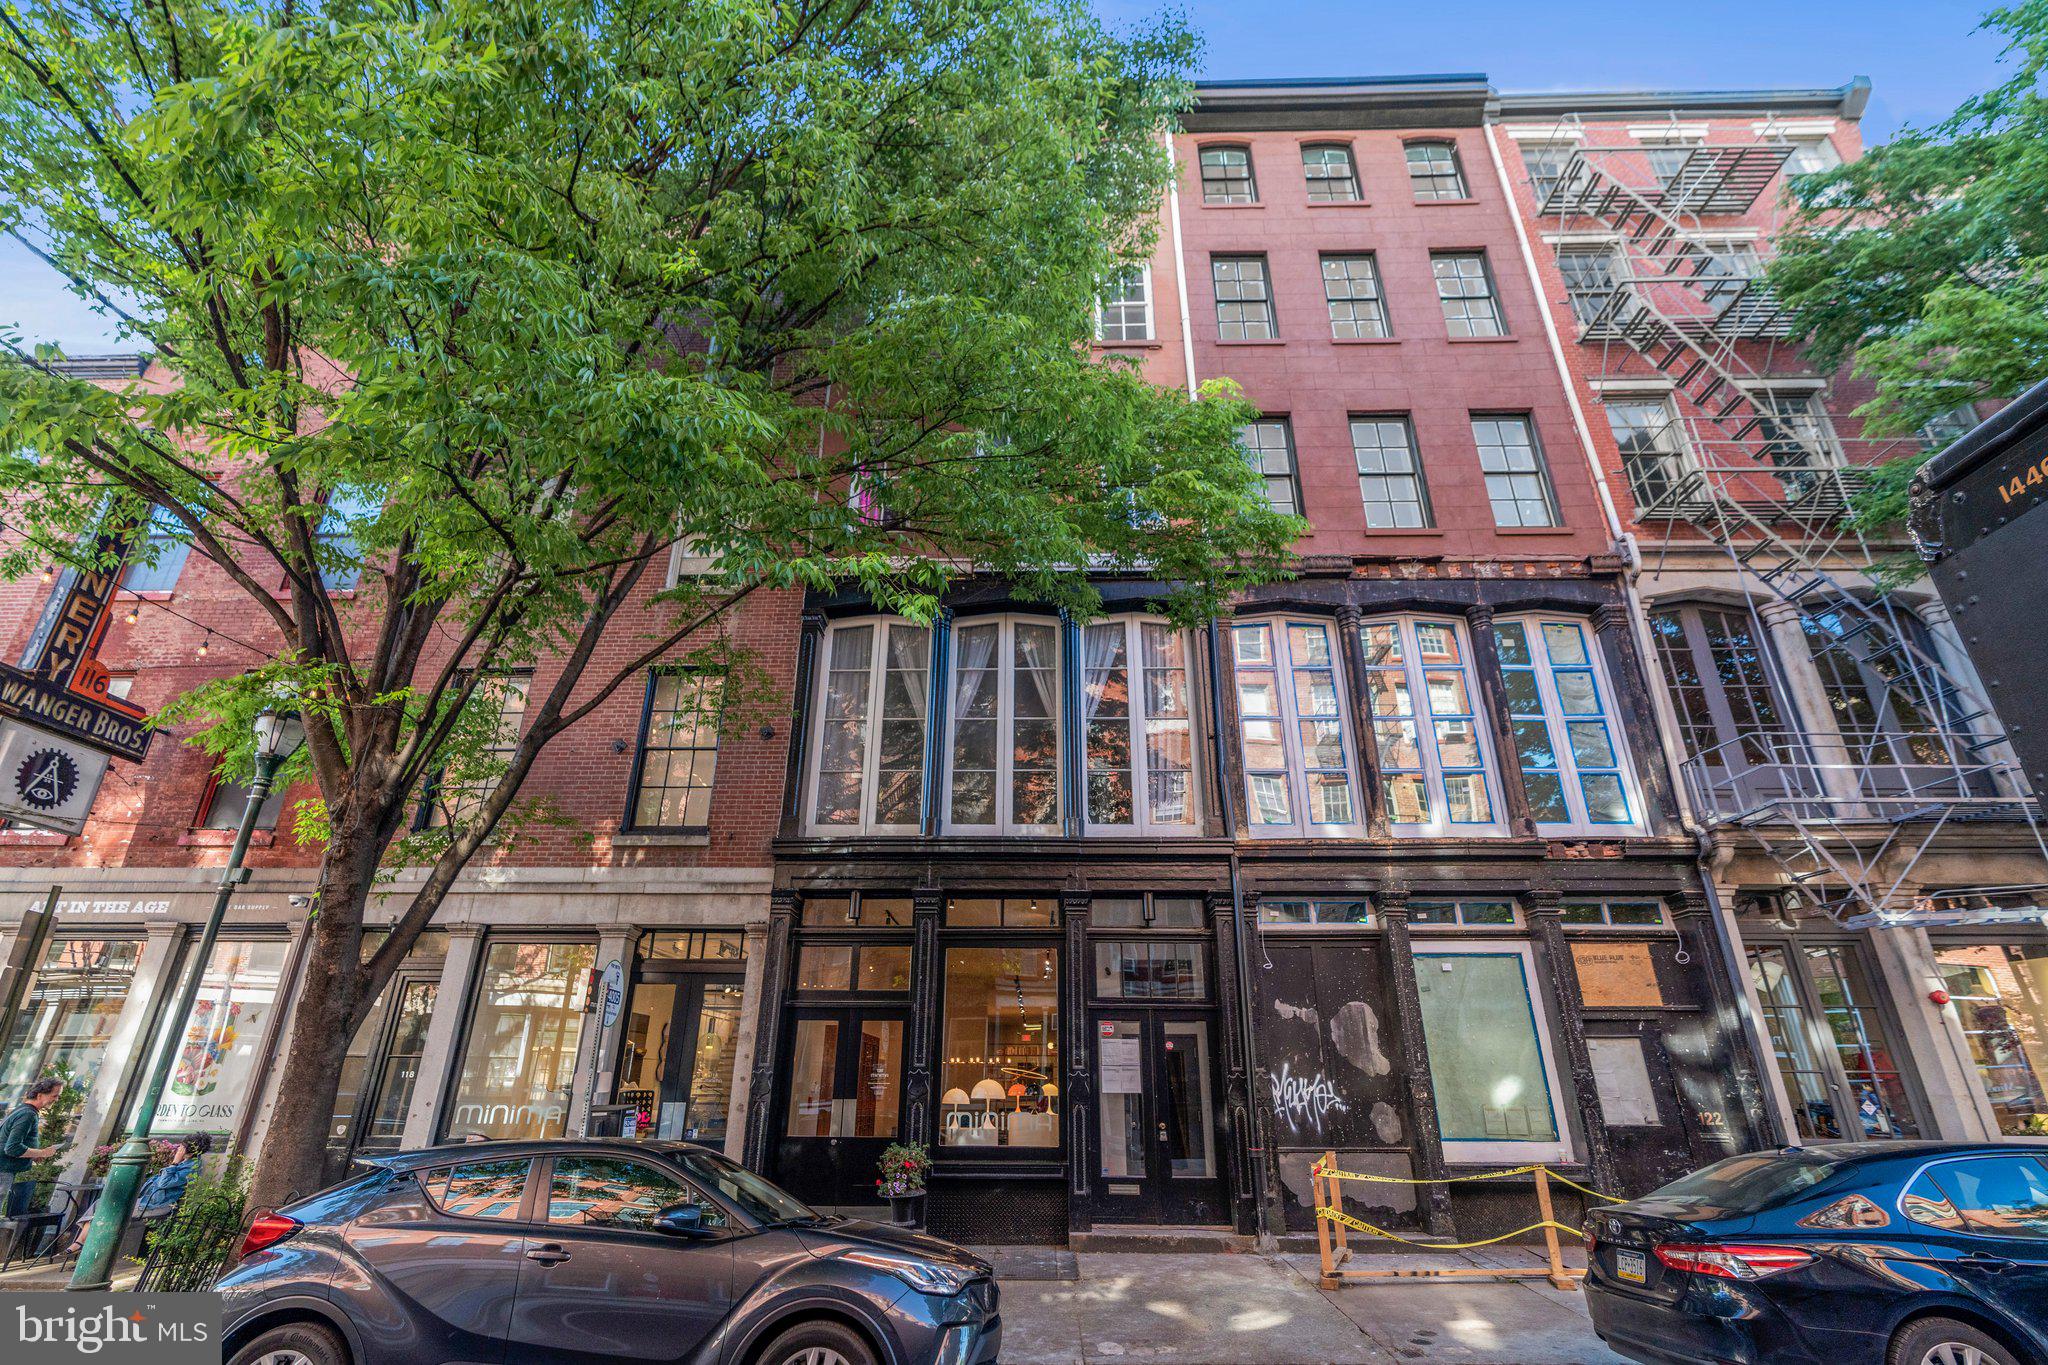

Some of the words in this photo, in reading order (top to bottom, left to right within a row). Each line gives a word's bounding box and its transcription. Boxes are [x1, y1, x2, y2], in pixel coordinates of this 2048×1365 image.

[79, 667, 108, 694] 116
[1, 681, 93, 731] WANGER
[64, 901, 90, 913] IN
[92, 901, 130, 913] THE
[130, 901, 170, 913] AGE
[401, 1070, 415, 1078] 118
[180, 1104, 198, 1117] TO
[198, 1104, 235, 1118] GLASS
[1697, 1111, 1724, 1126] 122
